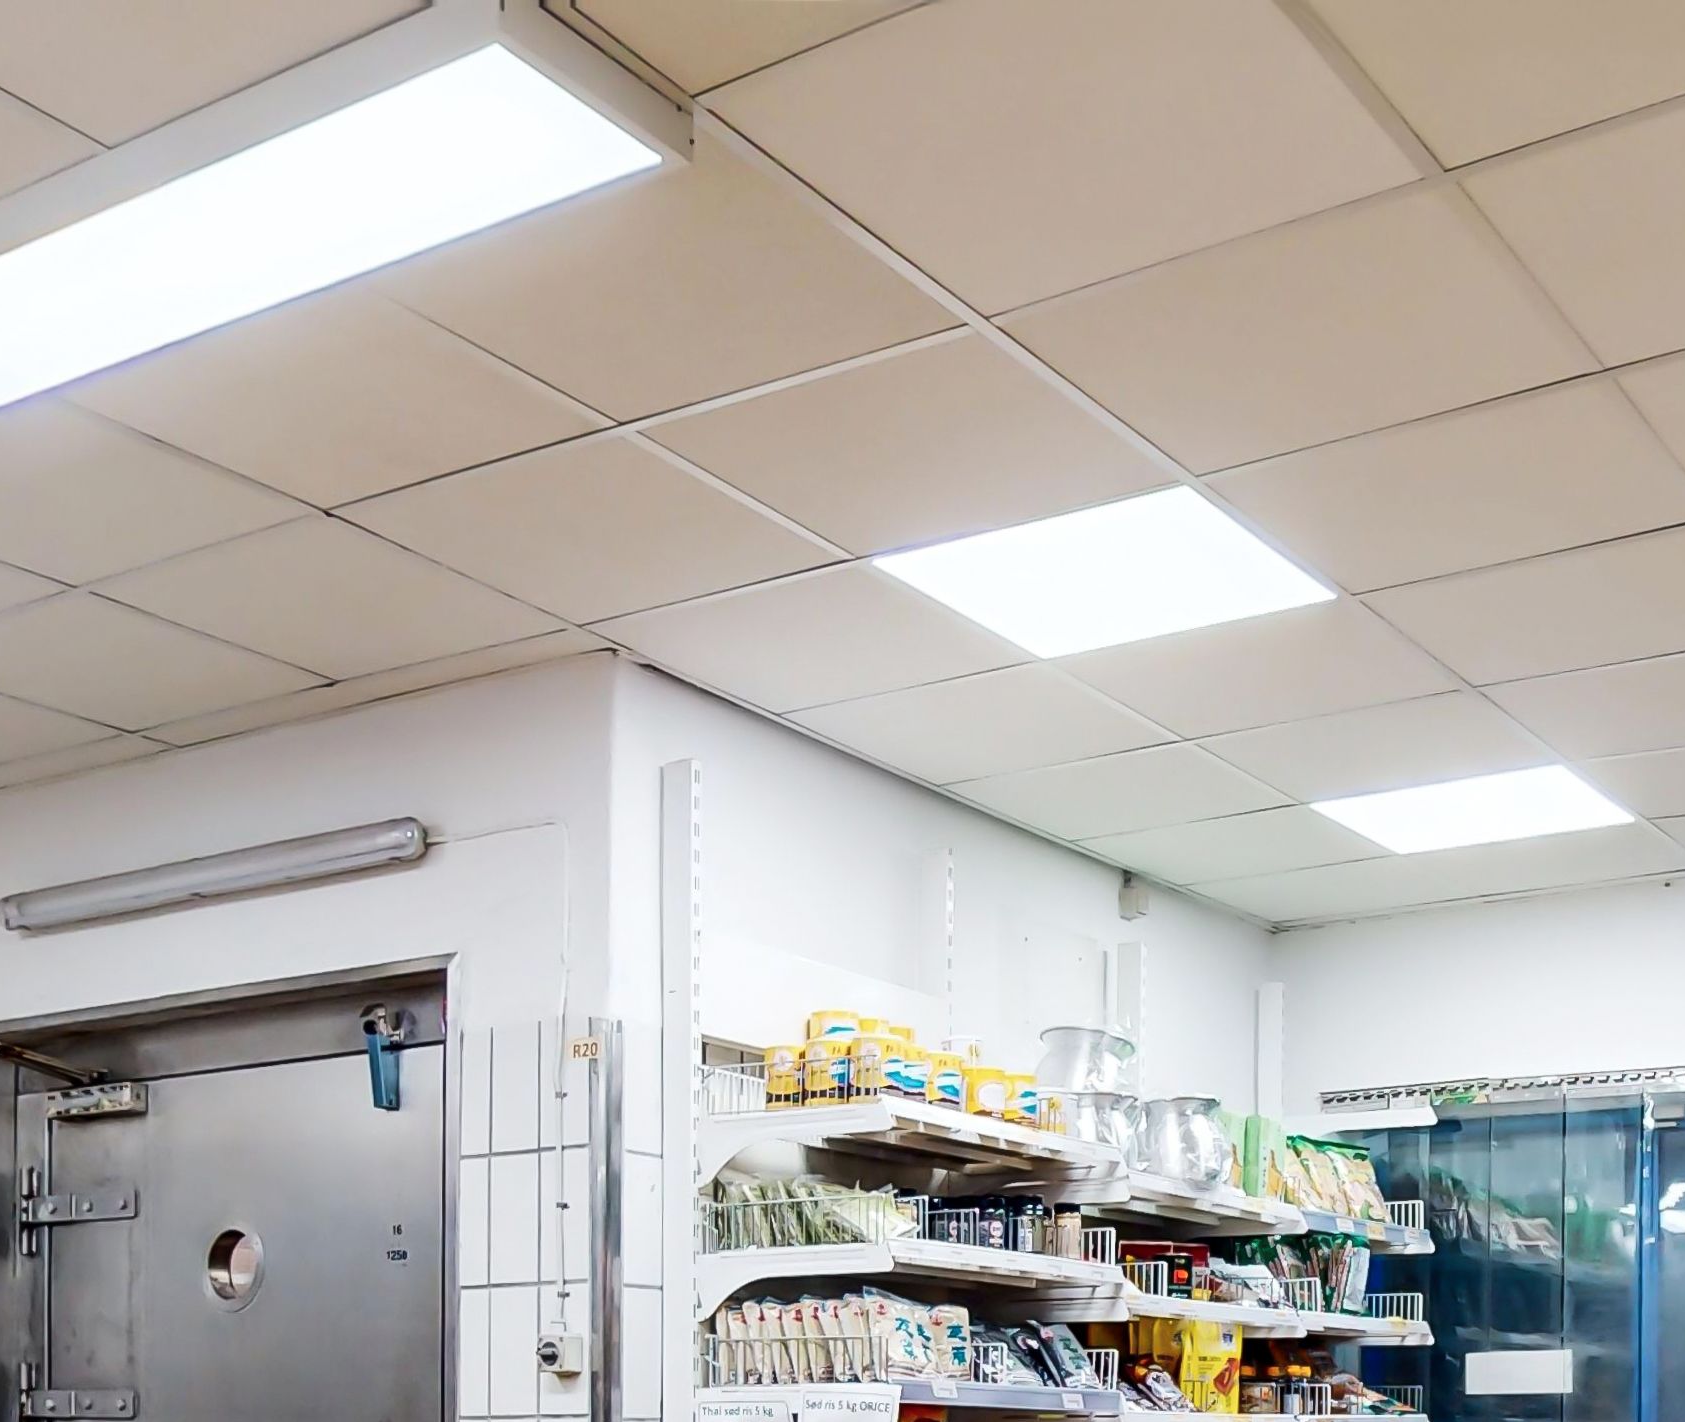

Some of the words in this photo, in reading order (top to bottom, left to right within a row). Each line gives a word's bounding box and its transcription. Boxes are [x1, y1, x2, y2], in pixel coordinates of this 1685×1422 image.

[573, 1042, 598, 1058] R20
[825, 1400, 835, 1410] ris
[702, 1406, 722, 1416] Thai
